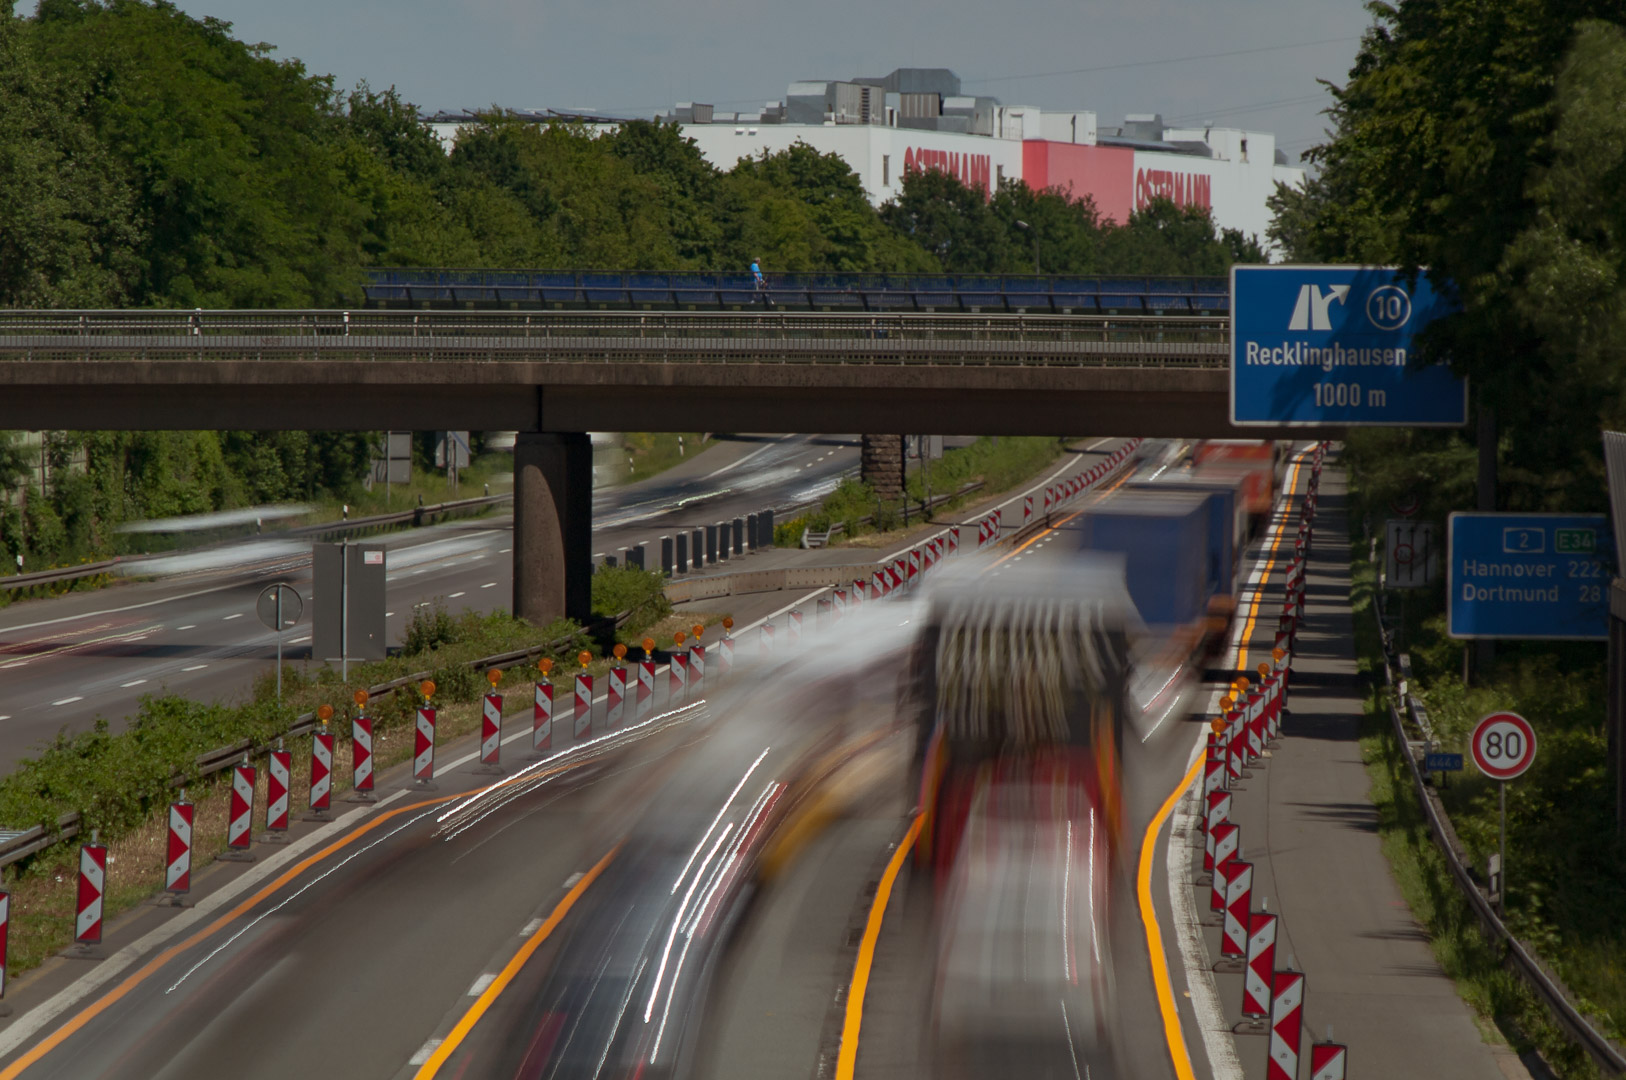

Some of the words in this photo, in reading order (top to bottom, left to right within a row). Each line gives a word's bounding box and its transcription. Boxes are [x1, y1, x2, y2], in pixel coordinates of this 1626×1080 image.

[1136, 167, 1211, 217] OSTERMANN
[1376, 296, 1401, 320] 10
[1246, 341, 1406, 372] Recklinghausen
[1313, 383, 1361, 407] 1000
[1368, 388, 1386, 407] m
[1519, 533, 1529, 548] 2
[1463, 560, 1556, 577] Hannover
[1568, 561, 1601, 578] 222
[1463, 583, 1559, 602] Dortmund
[1578, 585, 1601, 603] 28
[1486, 732, 1522, 759] 80
